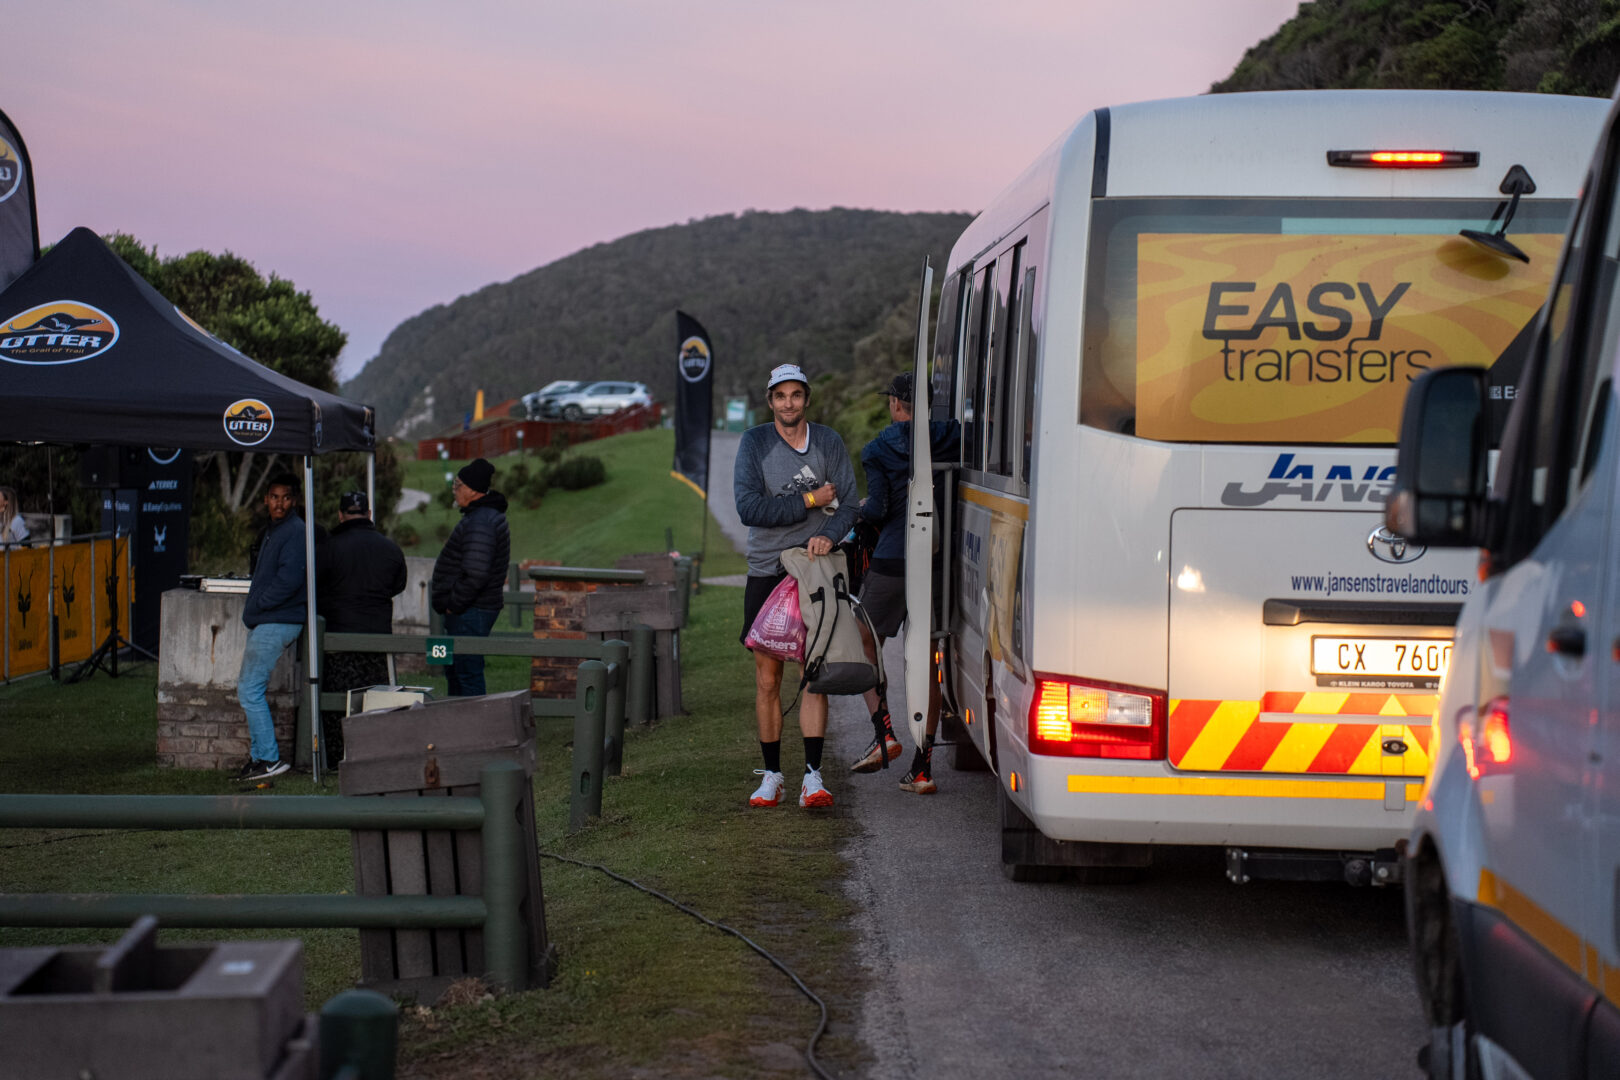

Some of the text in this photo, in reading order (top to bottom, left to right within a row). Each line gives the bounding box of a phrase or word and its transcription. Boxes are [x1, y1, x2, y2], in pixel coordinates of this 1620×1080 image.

[1202, 282, 1412, 341] EASY
[0, 333, 102, 349] OTTER
[1220, 338, 1432, 383] transfers
[229, 420, 268, 431] OTTER
[1221, 453, 1397, 507] JANS
[1292, 571, 1471, 596] www.jansenstravelandtours.
[432, 645, 446, 658] 63
[1338, 643, 1366, 670] CX
[1387, 681, 1414, 689] TOYOTA
